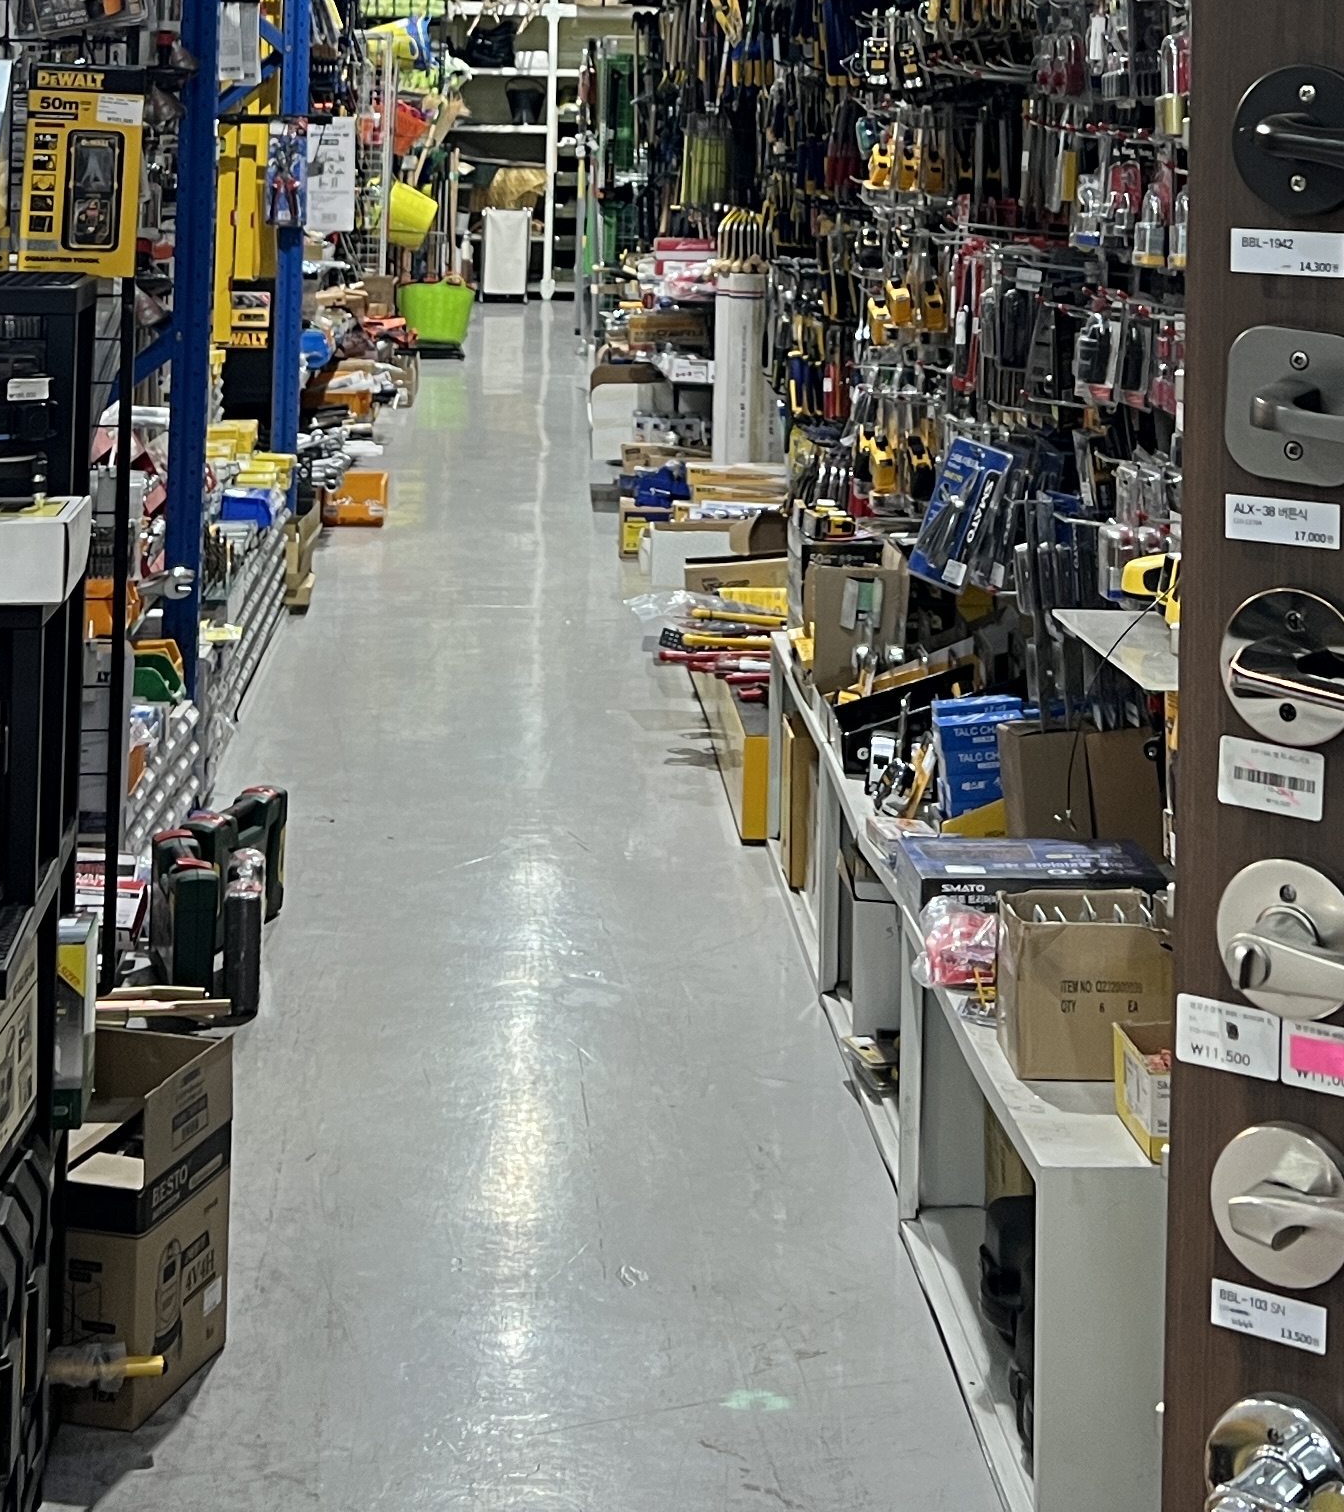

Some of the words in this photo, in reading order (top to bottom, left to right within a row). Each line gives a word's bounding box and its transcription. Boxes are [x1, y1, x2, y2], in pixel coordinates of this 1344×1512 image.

[37, 69, 105, 90] DEWALT
[40, 96, 80, 111] 50m
[1240, 236, 1294, 250] BBL-1942
[230, 331, 269, 347] WALT
[941, 884, 986, 893] SMATO
[1190, 1041, 1252, 1067] ₩11,500
